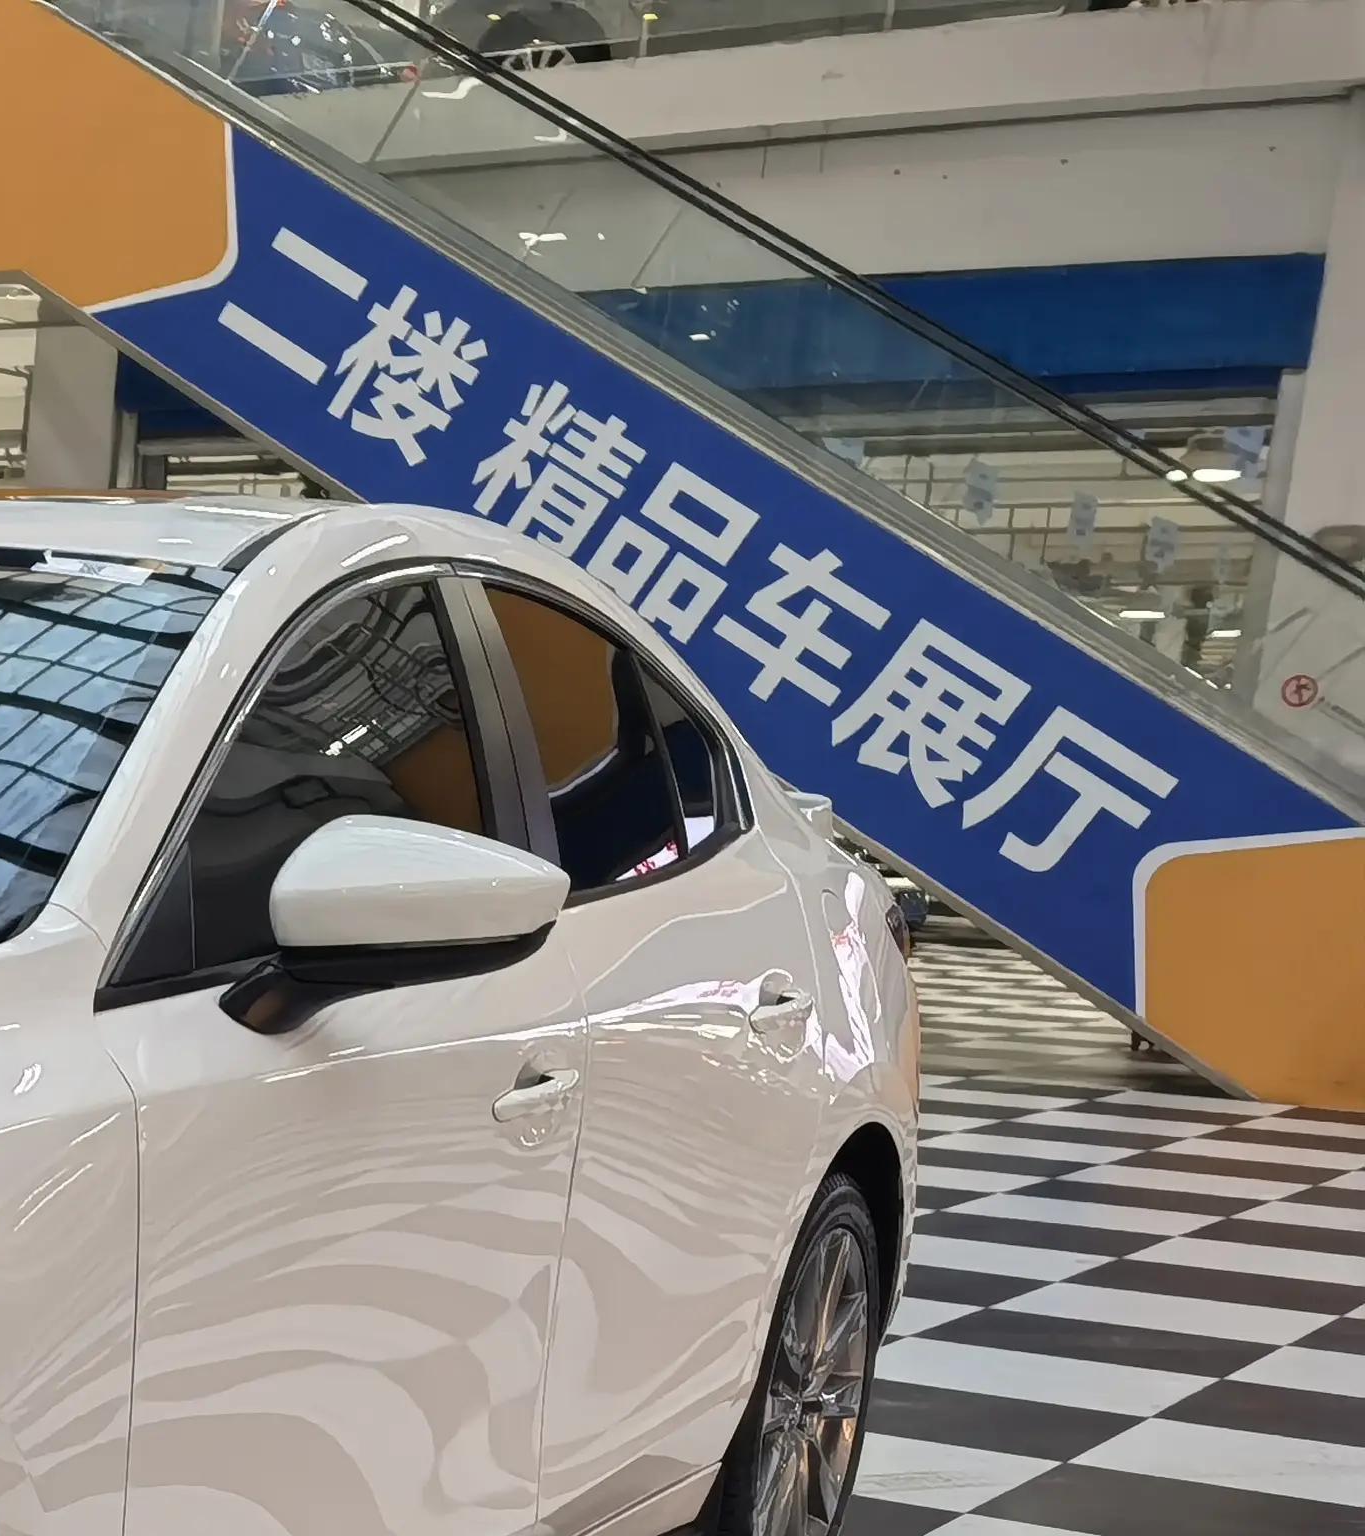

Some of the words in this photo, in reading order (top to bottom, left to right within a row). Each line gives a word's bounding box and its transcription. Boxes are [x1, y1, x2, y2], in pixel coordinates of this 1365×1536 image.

[219, 228, 488, 467] 二楼
[473, 381, 1179, 873] 精品车展厅
